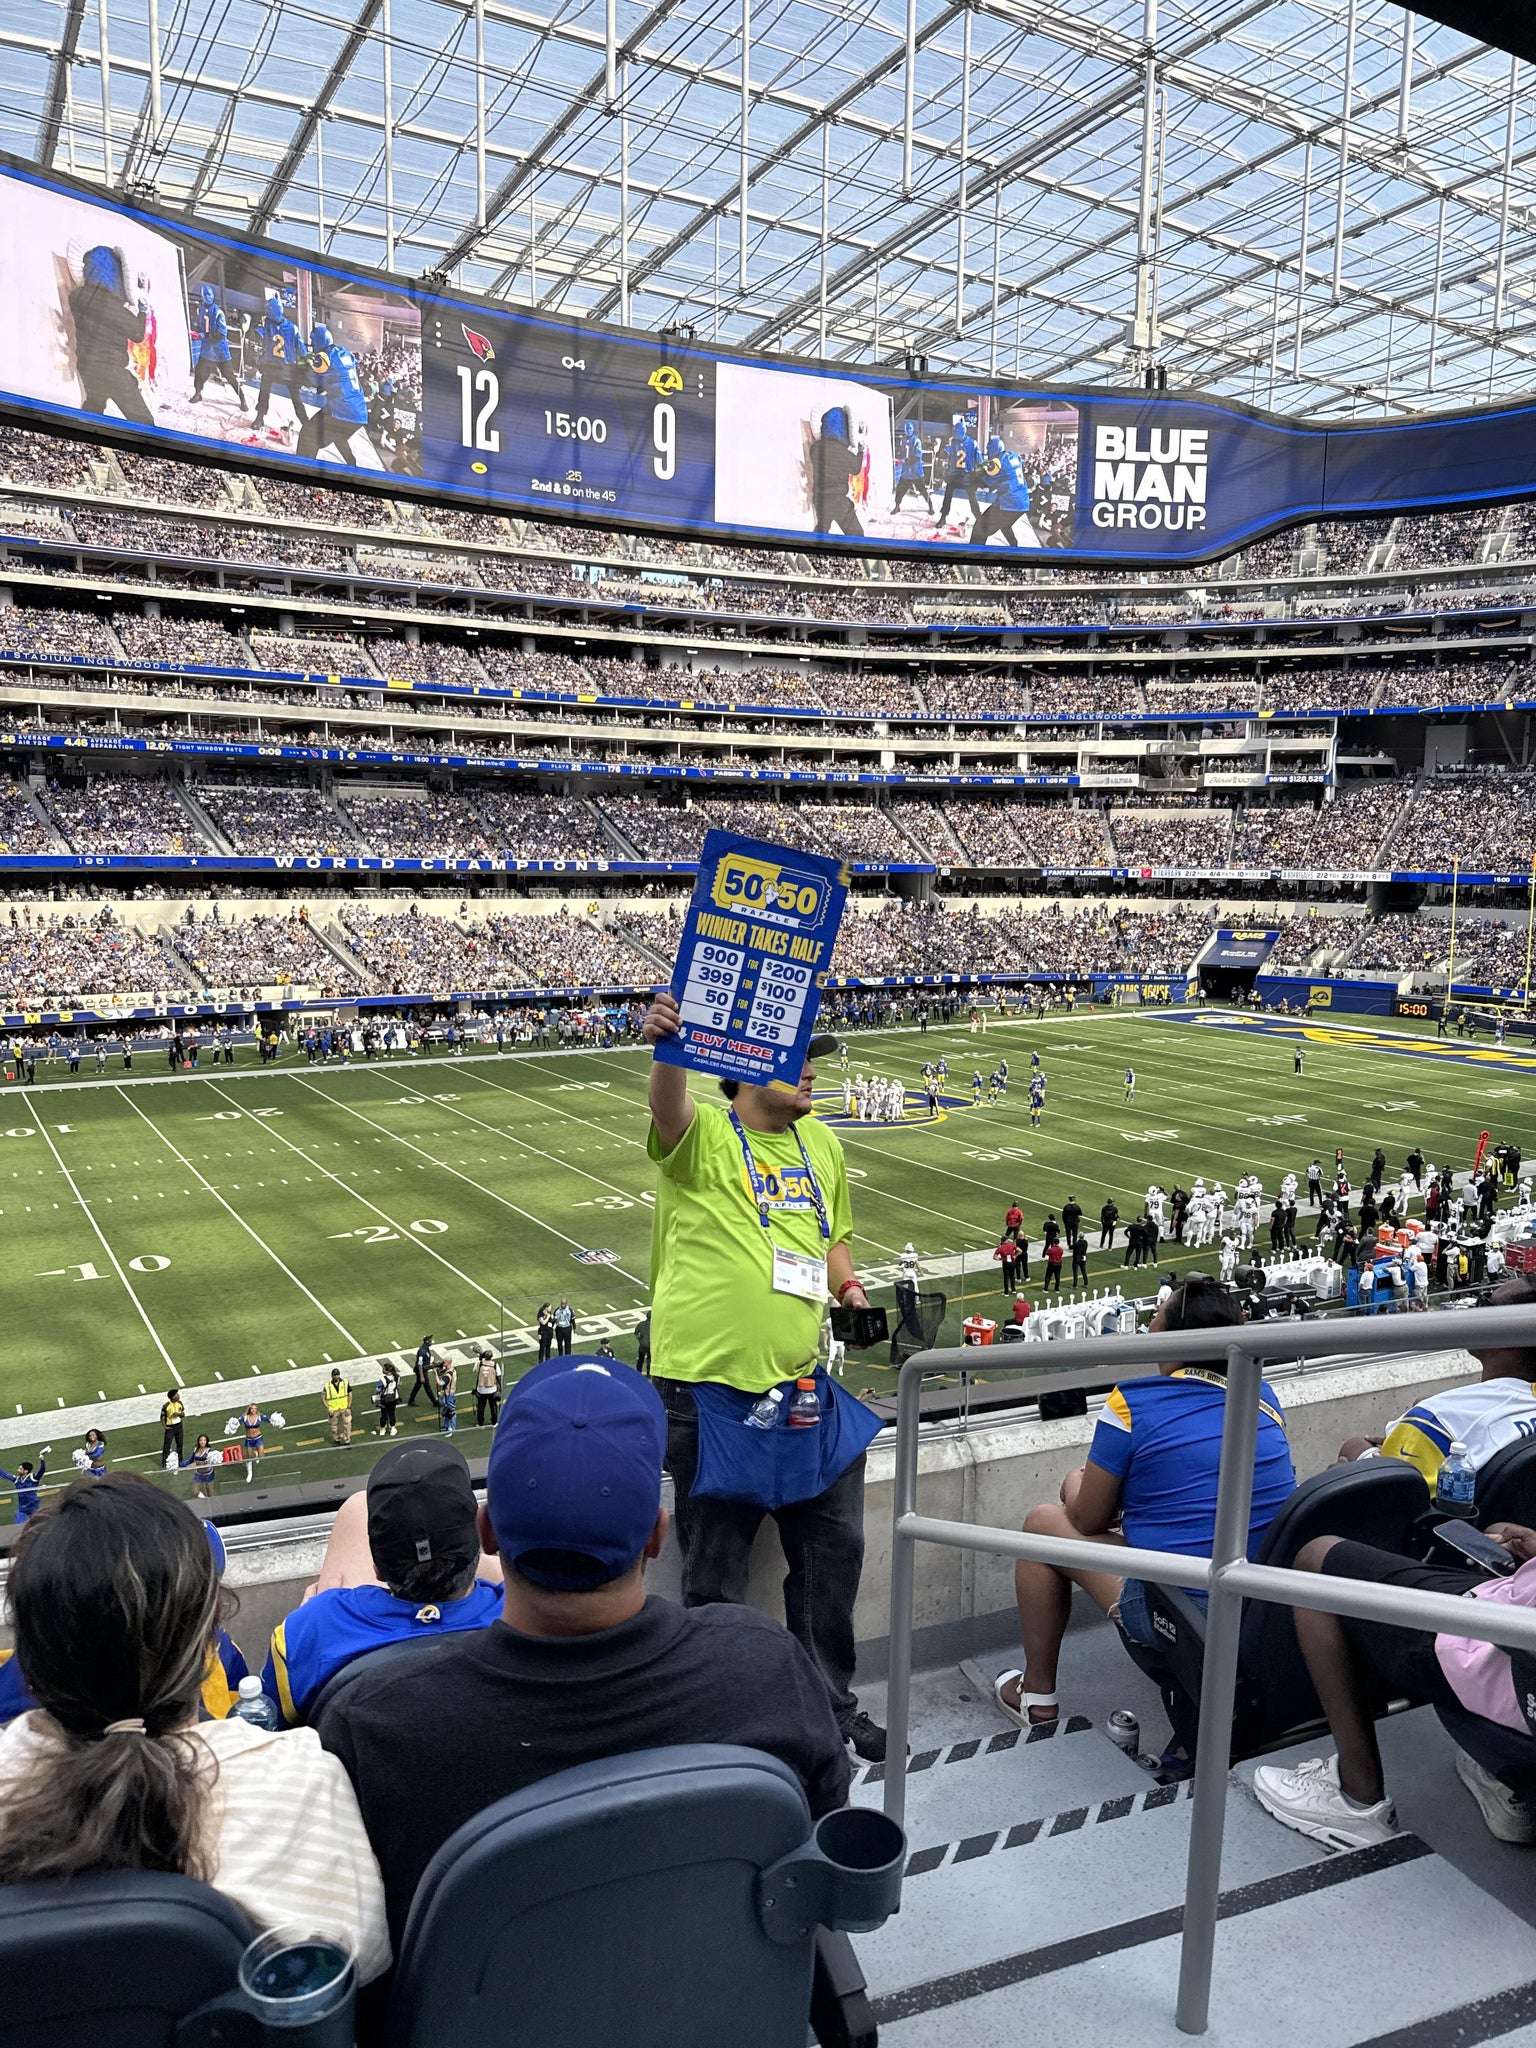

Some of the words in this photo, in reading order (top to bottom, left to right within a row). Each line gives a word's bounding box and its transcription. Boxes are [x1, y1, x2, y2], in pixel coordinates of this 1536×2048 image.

[271, 334, 286, 358] 2
[561, 356, 586, 371] Q4
[457, 365, 500, 453] 12
[544, 410, 607, 444] 15:00
[653, 402, 676, 480] 9
[1095, 425, 1208, 464] BLUE
[955, 449, 967, 469] 2
[531, 479, 553, 494] 2nd
[553, 482, 562, 495] &
[562, 484, 572, 496] 9
[572, 488, 584, 499] on
[585, 487, 601, 500] the
[601, 490, 616, 502] 45
[1094, 461, 1207, 504] MAN
[82, 657, 164, 671] INGLEWOOD,
[169, 664, 186, 672] CA
[64, 738, 88, 747] 4.46
[145, 741, 173, 751] 12.0%
[258, 747, 282, 756] 0:09
[571, 763, 582, 772] 25
[607, 765, 621, 773] 176
[78, 857, 111, 866] 1951
[274, 857, 395, 869] WORLD
[420, 859, 611, 872] CHAMPIONS
[1049, 869, 1080, 877] FANTASY
[1080, 869, 1111, 877] LEADERS
[724, 868, 764, 901] 50
[776, 883, 818, 915] 50
[740, 906, 790, 925] RAFFLE
[695, 912, 748, 946] WINNER
[748, 925, 789, 956] TAKES
[790, 935, 825, 964] HALF
[1231, 932, 1267, 941] RAMS
[702, 946, 739, 967] 900
[747, 959, 759, 971] FOR
[766, 961, 807, 984] $200
[698, 966, 734, 986] 399
[742, 978, 754, 991] FOR
[760, 982, 797, 1002] $100
[896, 974, 979, 985] HOUSE
[155, 1002, 283, 1017] HOUSE
[705, 990, 729, 1007] 50
[736, 998, 749, 1011] FOR
[755, 1001, 786, 1022] $50
[1399, 1003, 1428, 1016] 15:00
[711, 1011, 724, 1026] 5
[731, 1018, 743, 1030] FOR
[750, 1019, 780, 1041] $25
[691, 1030, 726, 1048] BUY
[727, 1039, 775, 1061] HERE
[693, 1056, 720, 1068] CASHLESS
[719, 1063, 747, 1074] PAYMENTS
[747, 1070, 761, 1078] ONLY
[962, 1146, 1034, 1162] 50
[768, 1201, 804, 1209] AFFLE
[1149, 1200, 1160, 1210] 79
[353, 1218, 449, 1244] 20
[67, 1253, 172, 1282] 10
[903, 1260, 916, 1270] 38
[1184, 1367, 1206, 1378] RAMS
[226, 1447, 240, 1460] 10
[1153, 1611, 1169, 1630] SoFi
[1153, 1620, 1177, 1643] Stadium
